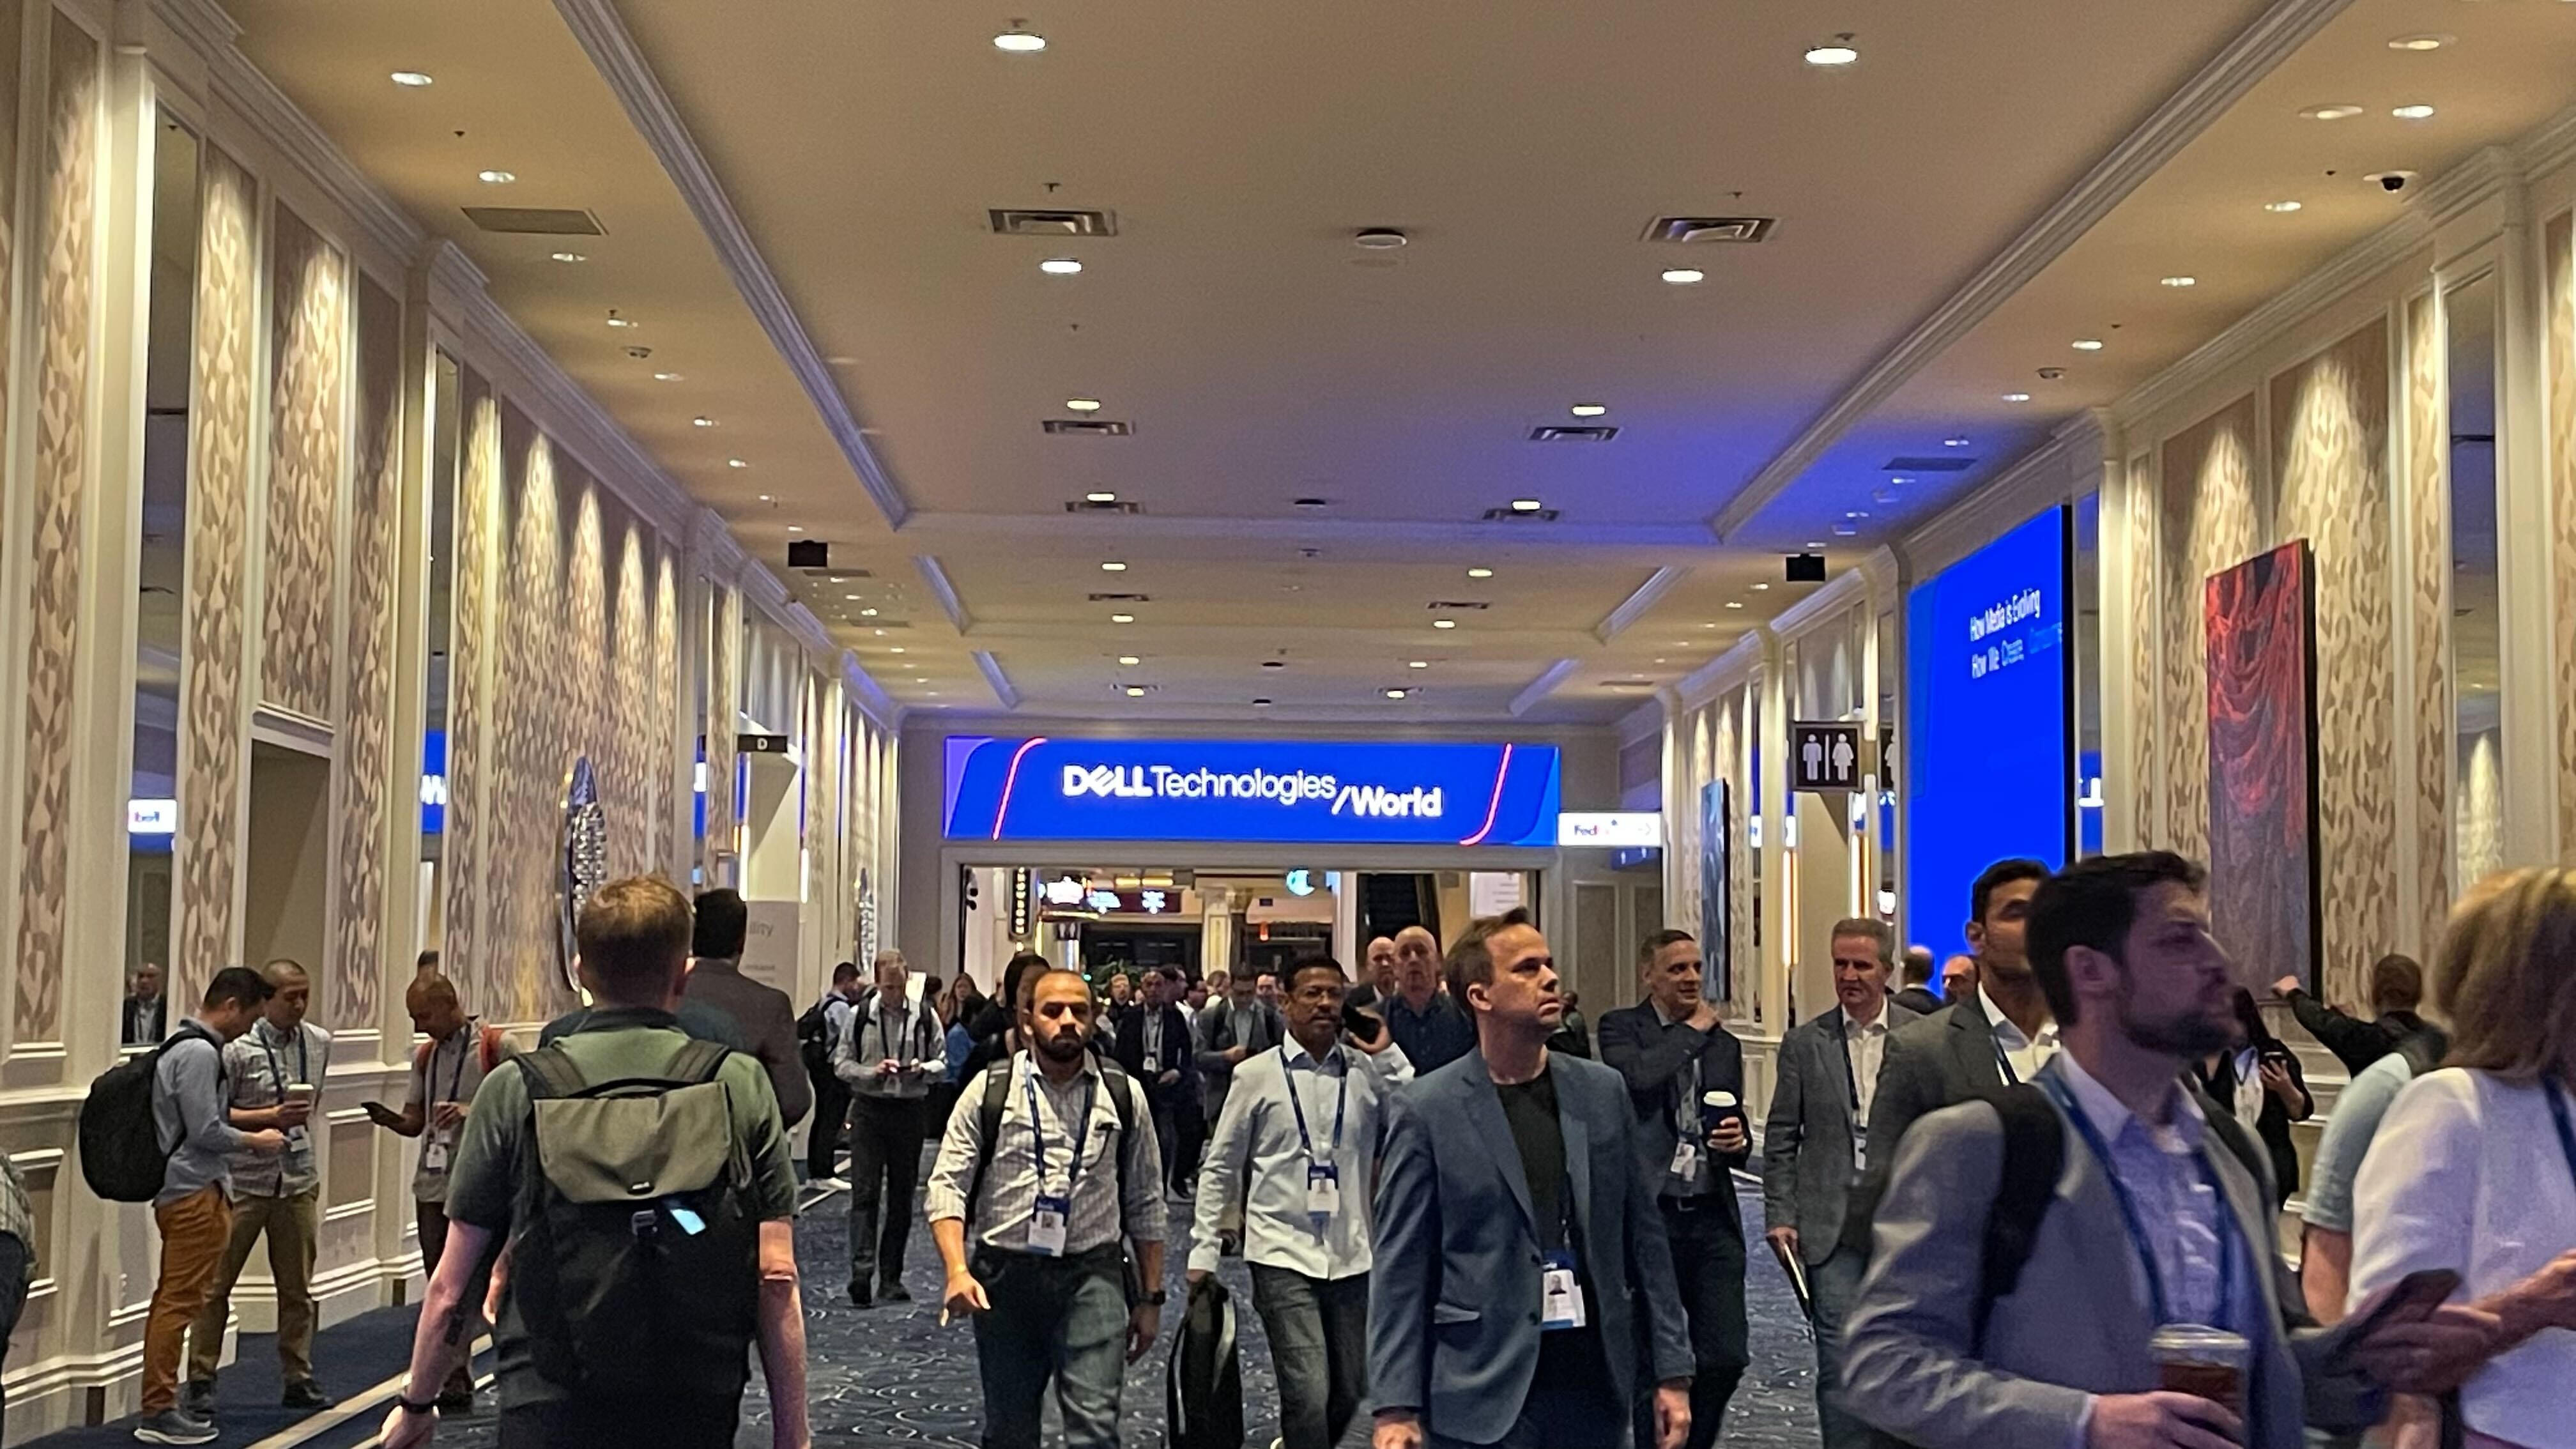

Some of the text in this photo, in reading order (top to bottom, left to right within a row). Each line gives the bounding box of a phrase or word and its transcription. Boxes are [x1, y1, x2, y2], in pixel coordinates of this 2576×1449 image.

[756, 737, 768, 750] D
[1062, 765, 1151, 798] DELL
[1150, 765, 1337, 806] Technologies
